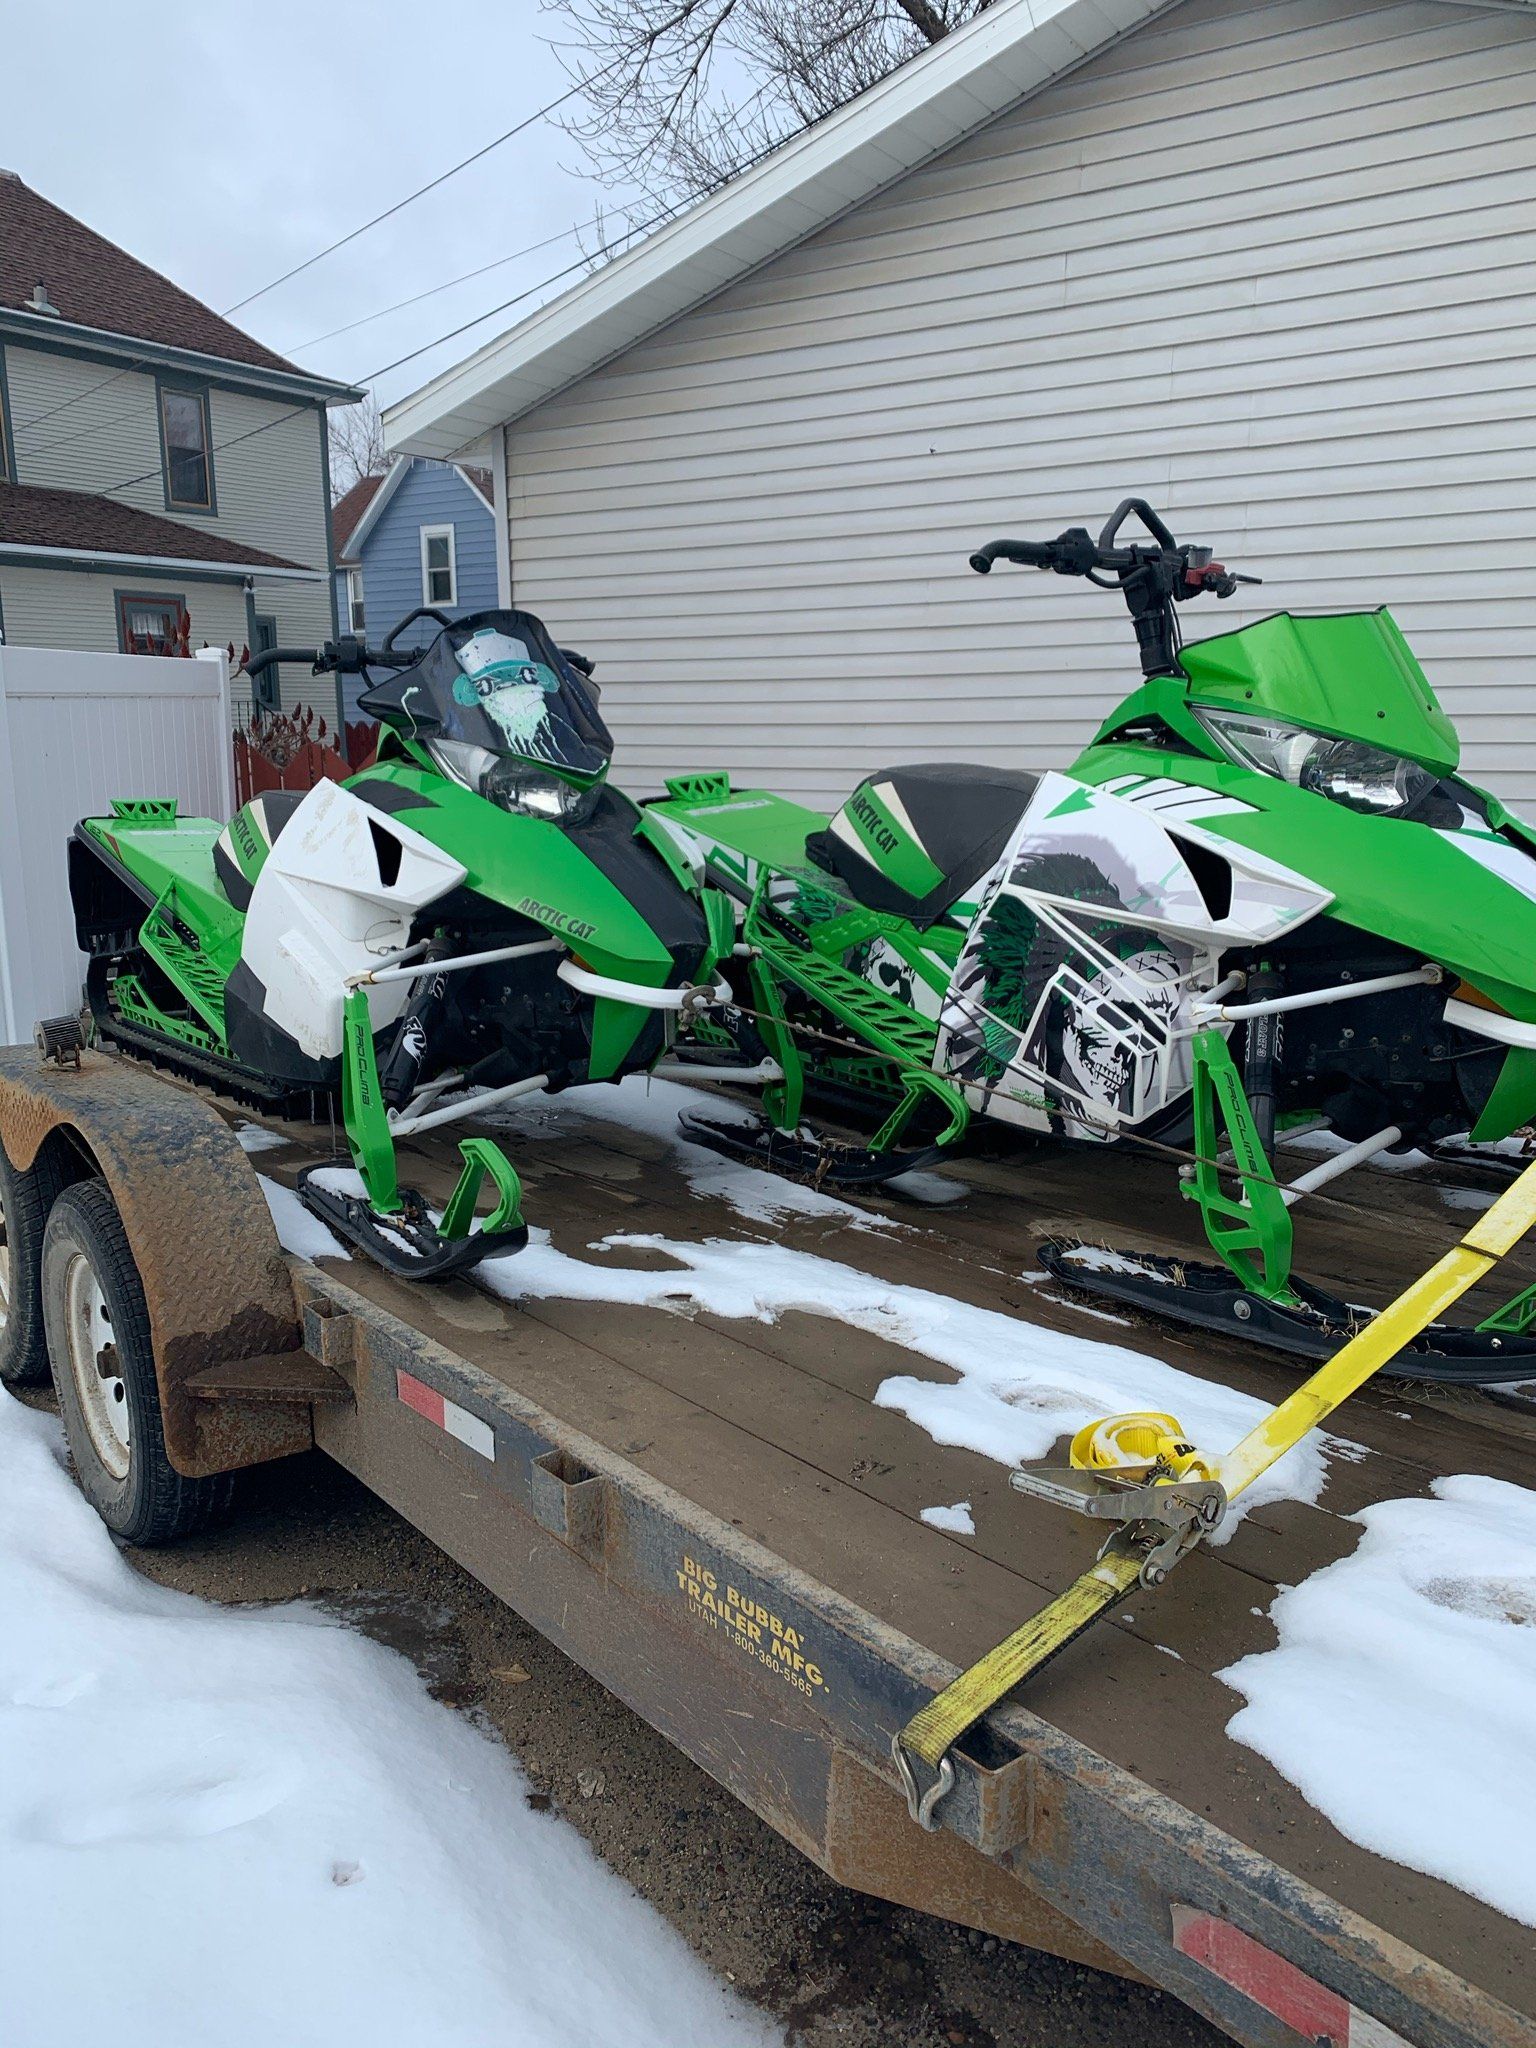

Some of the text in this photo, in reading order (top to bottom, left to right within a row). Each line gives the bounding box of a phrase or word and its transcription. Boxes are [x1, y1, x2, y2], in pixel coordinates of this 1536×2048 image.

[851, 793, 899, 855] ARCTIC CAT
[243, 837, 258, 860] CAT
[517, 898, 596, 939] ARCTIC CAT
[1257, 1014, 1269, 1049] LOAT
[684, 1555, 717, 1591] BIG
[676, 1569, 830, 1694] TRAILER MFG.
[689, 1598, 813, 1697] UTAH 1-800-360-5565
